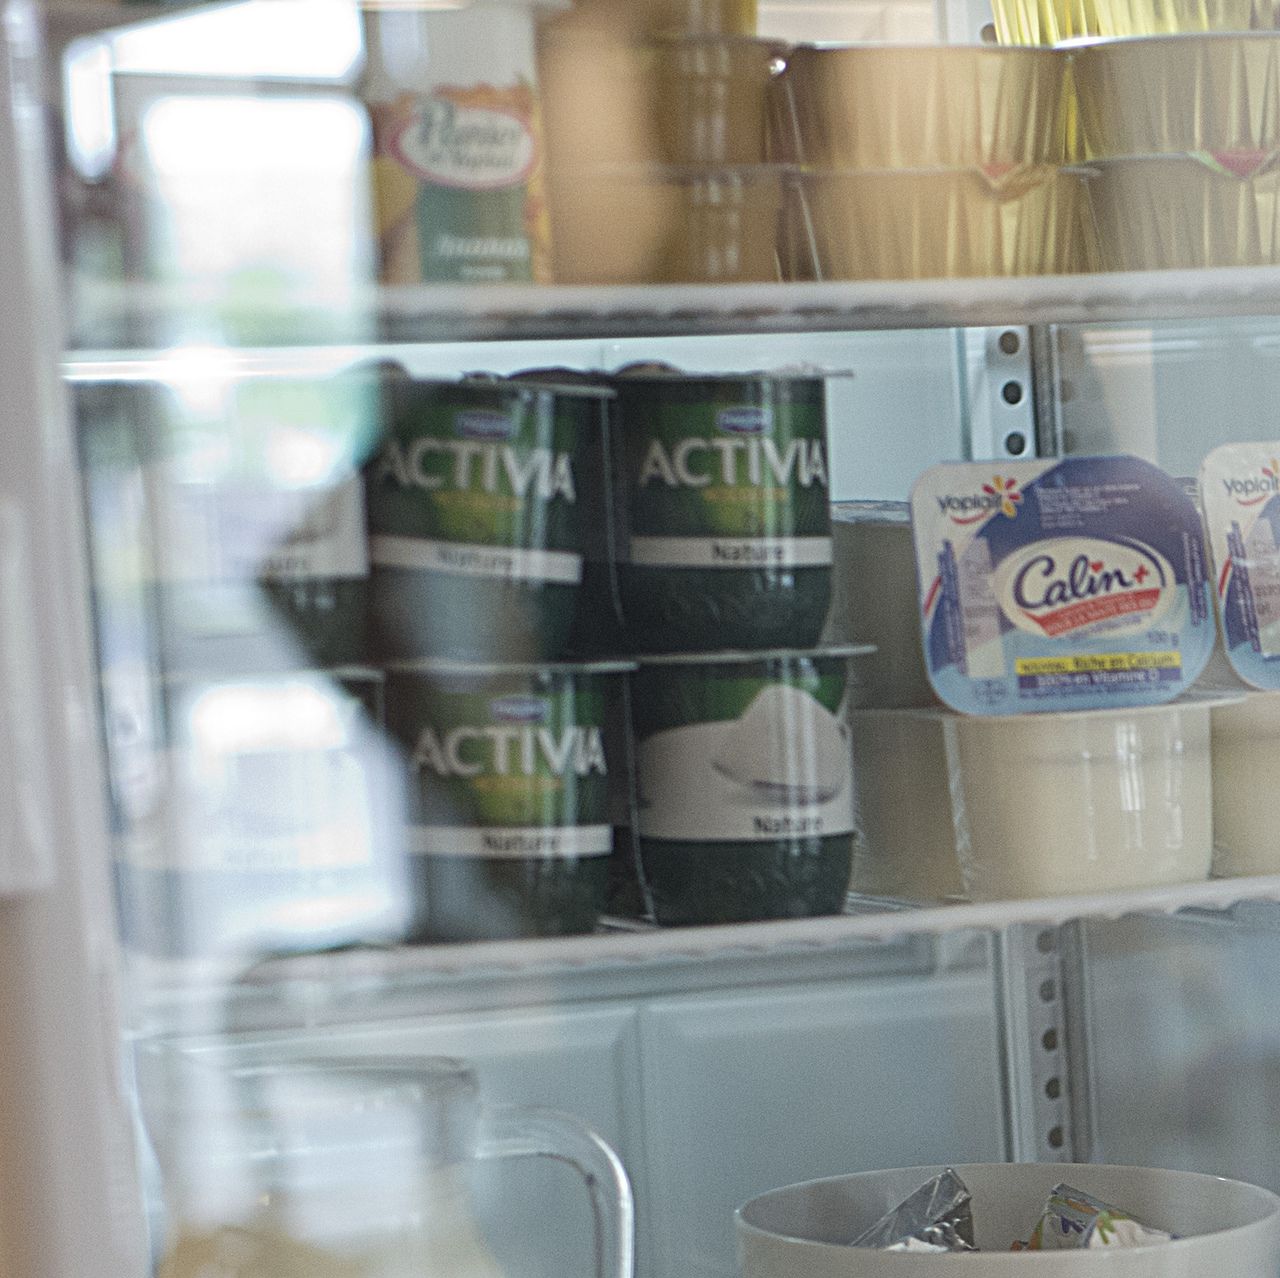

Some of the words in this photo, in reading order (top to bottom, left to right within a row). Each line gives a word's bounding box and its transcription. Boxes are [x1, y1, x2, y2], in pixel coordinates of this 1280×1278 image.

[378, 437, 576, 503] ACTIVIA
[638, 437, 828, 488] ACTIVIA
[1223, 475, 1279, 497] Yoplait
[711, 543, 786, 561] Nature
[411, 726, 608, 776] ACTIVIA
[753, 815, 824, 834] Nature
